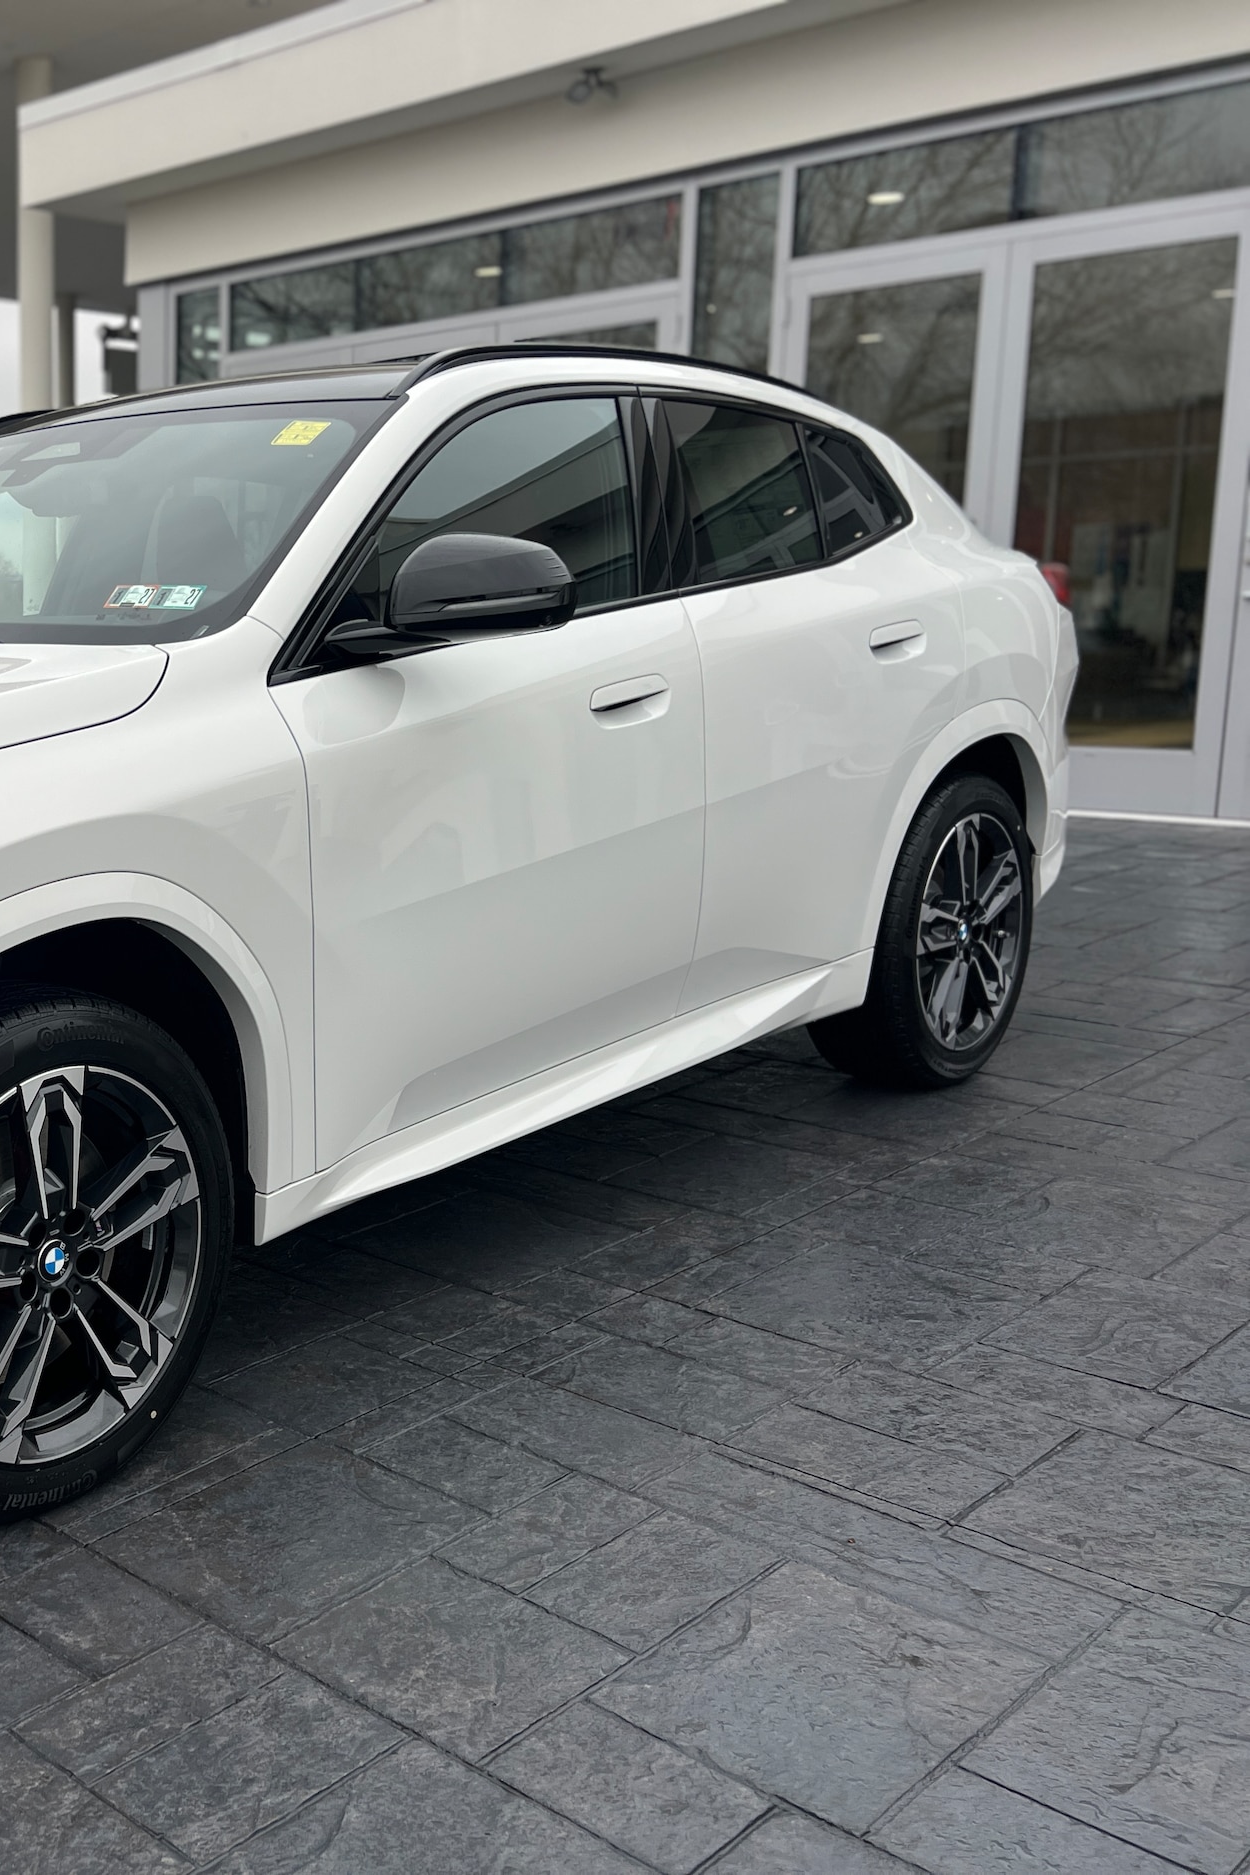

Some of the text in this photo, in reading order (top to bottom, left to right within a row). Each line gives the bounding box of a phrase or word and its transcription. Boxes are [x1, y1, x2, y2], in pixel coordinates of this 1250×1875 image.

[138, 588, 154, 605] 27
[183, 589, 201, 606] 27
[36, 1021, 126, 1052] Continental
[59, 1241, 70, 1276] BMW
